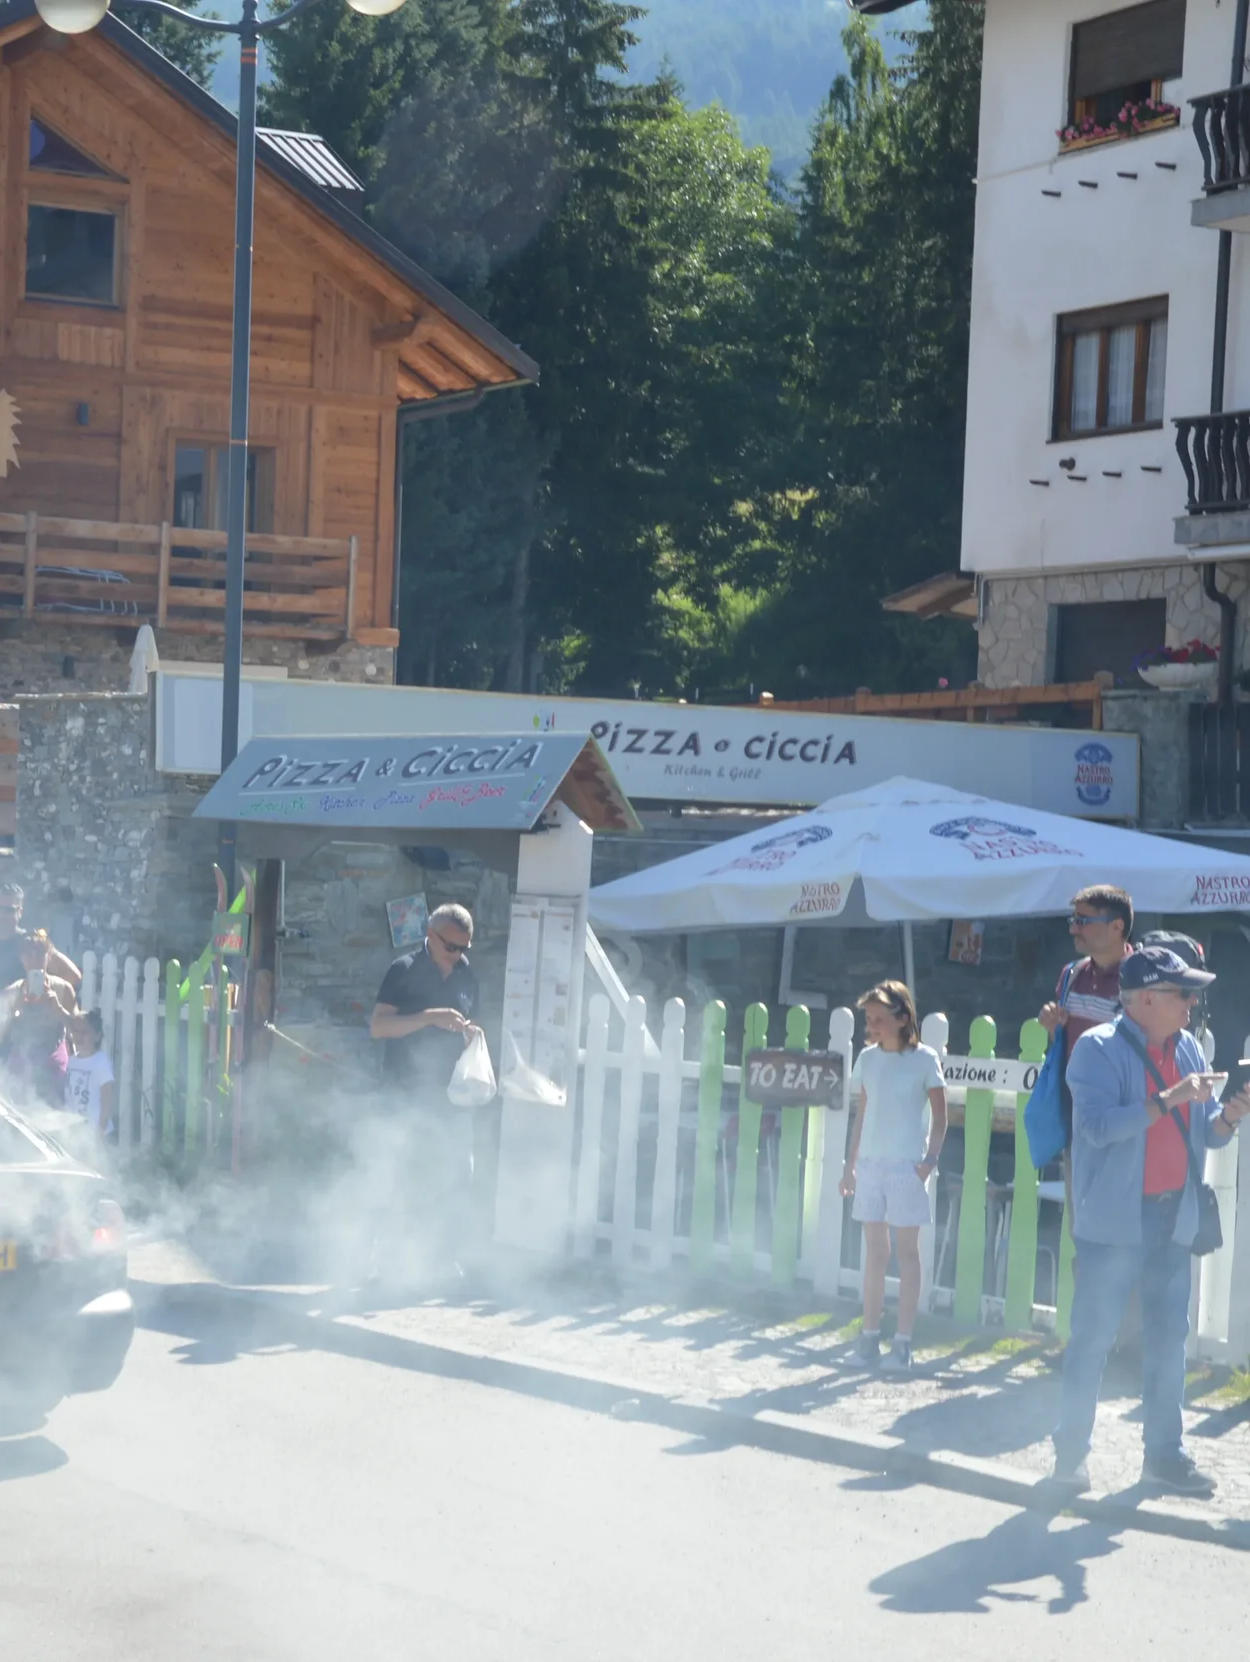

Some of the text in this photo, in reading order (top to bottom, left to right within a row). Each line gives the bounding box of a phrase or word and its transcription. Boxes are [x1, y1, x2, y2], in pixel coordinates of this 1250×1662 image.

[375, 757, 397, 778] &
[664, 763, 712, 778] Kitchen
[729, 767, 762, 781] Grill
[1196, 875, 1250, 890] NASTRO
[750, 1062, 823, 1091] TO EAT
[941, 1061, 997, 1083] azione
